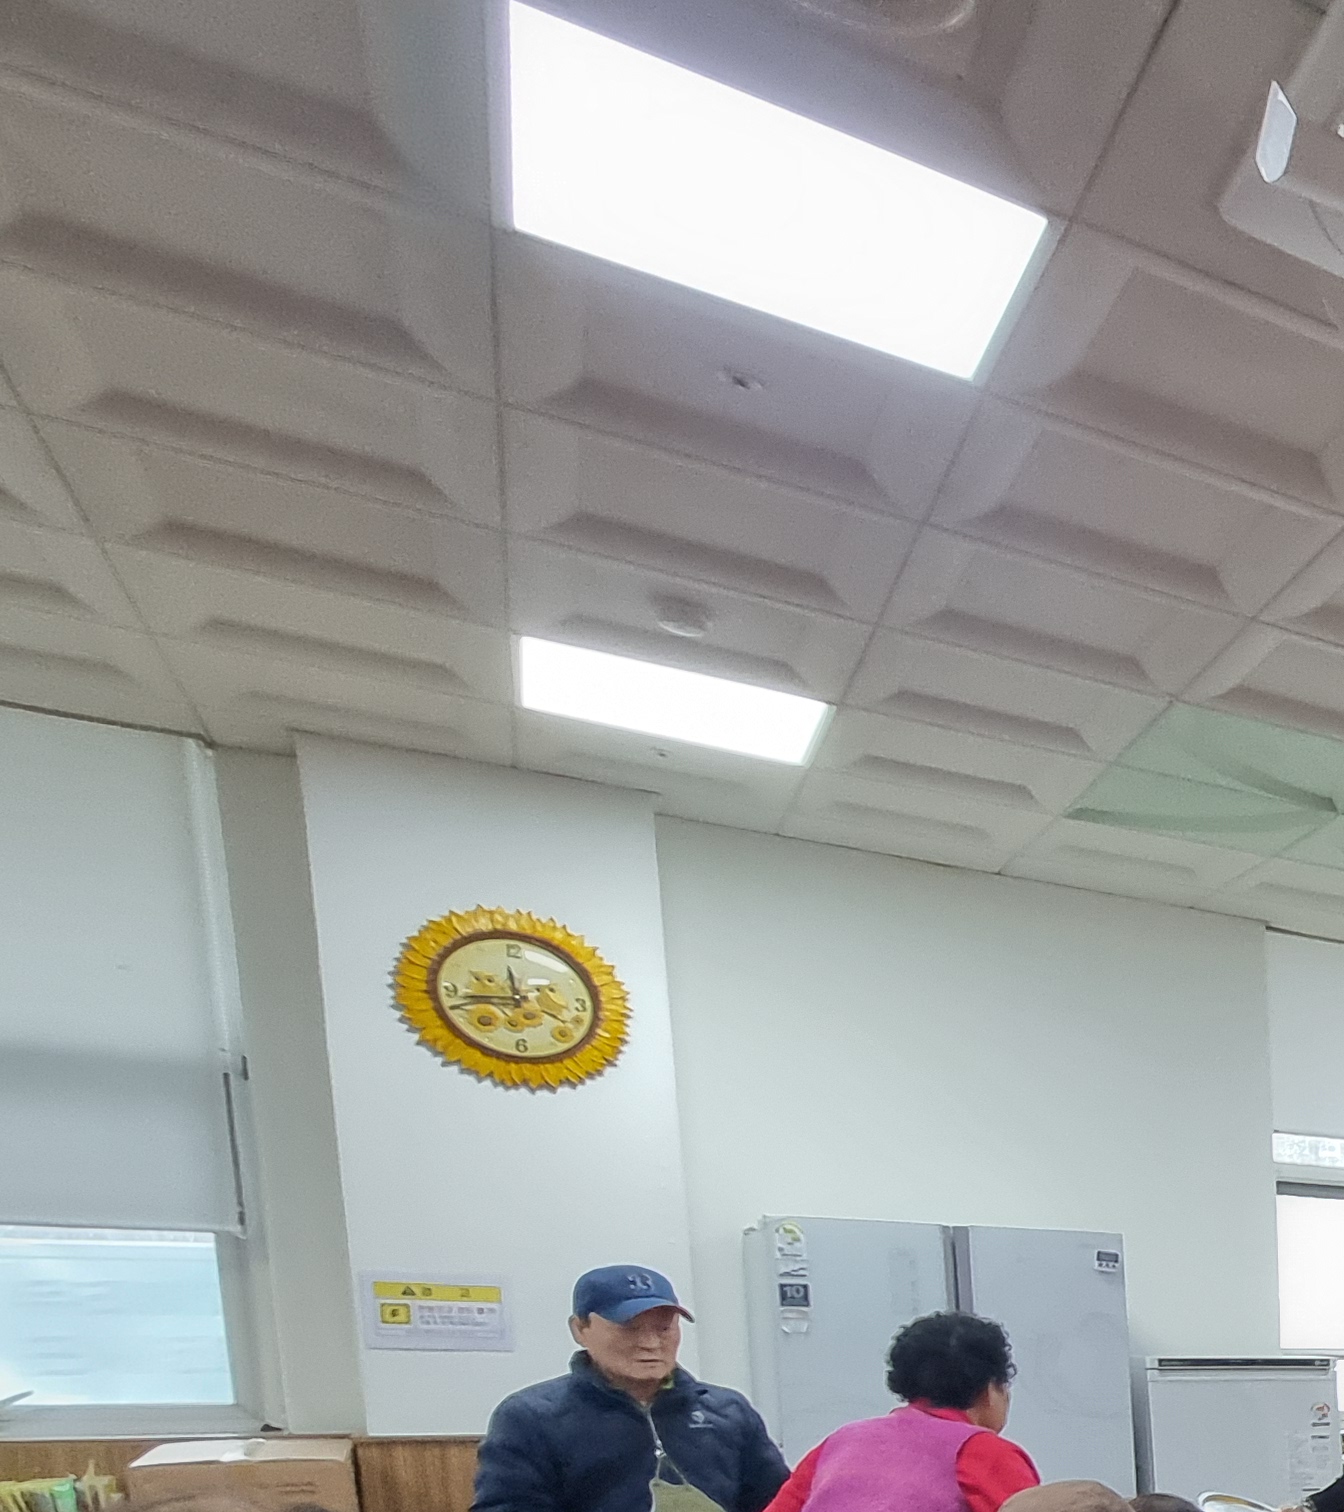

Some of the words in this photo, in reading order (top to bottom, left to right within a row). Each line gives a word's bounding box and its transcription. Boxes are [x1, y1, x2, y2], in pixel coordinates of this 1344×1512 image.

[505, 943, 522, 959] 12
[443, 981, 458, 998] 9
[574, 998, 587, 1013] 3
[515, 1038, 528, 1054] 6
